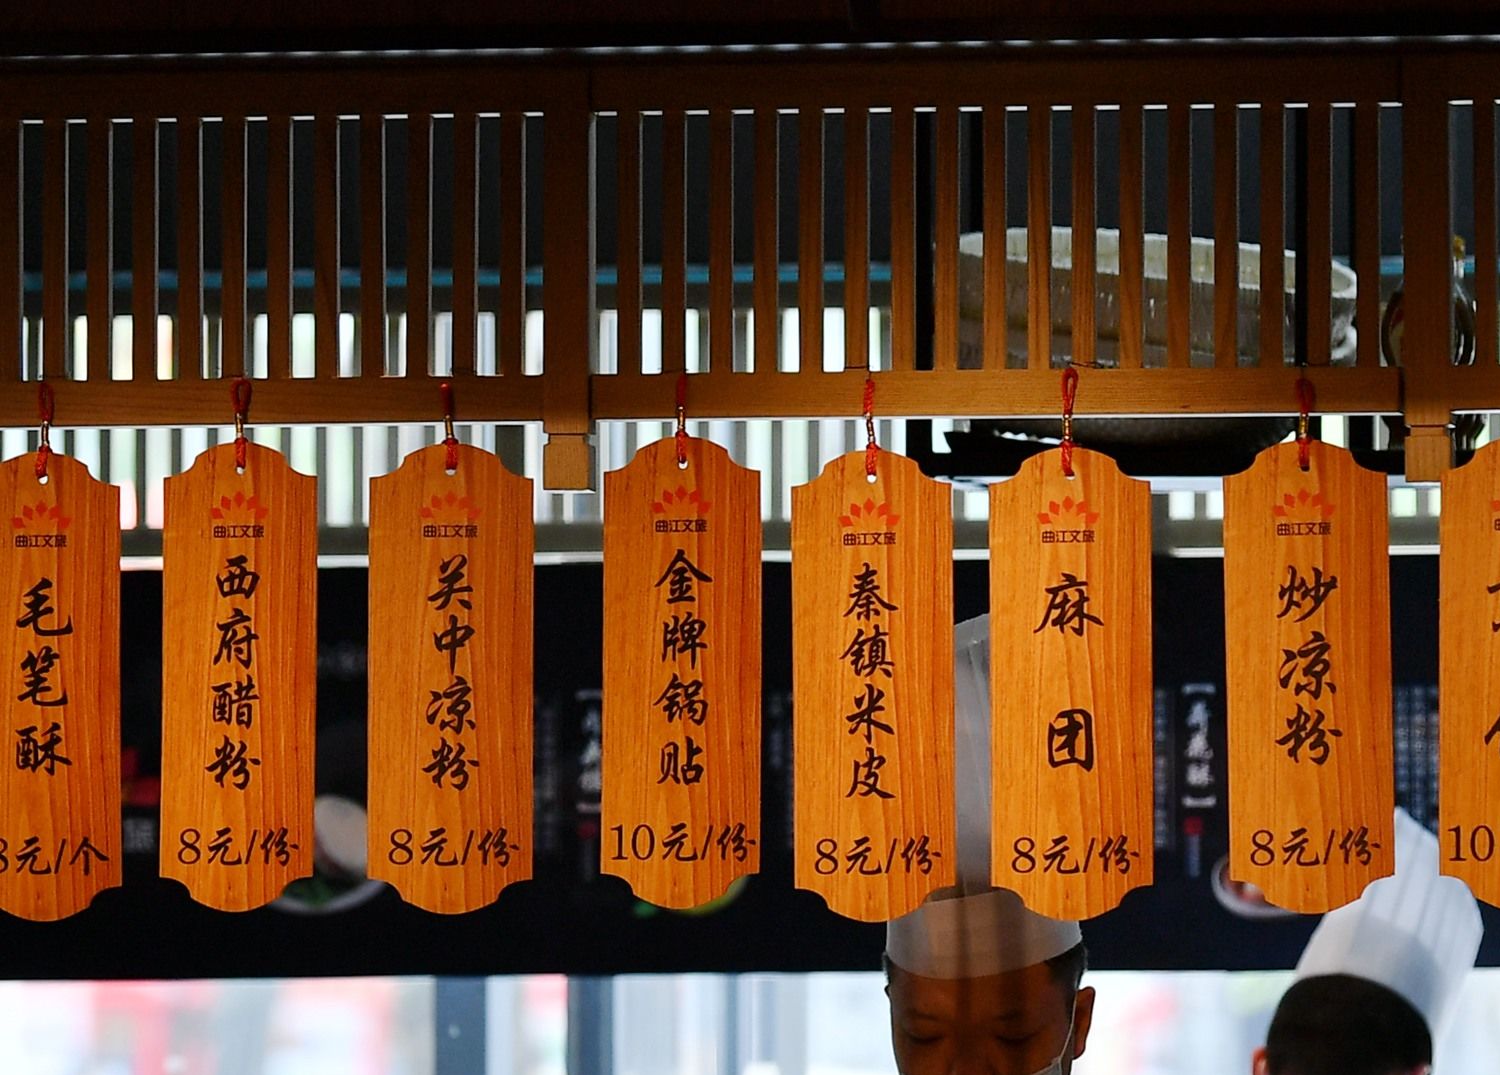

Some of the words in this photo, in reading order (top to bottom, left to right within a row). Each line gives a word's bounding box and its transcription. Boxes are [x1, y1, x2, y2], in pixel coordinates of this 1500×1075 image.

[14, 533, 67, 549] 曲江文旅
[213, 524, 265, 539] 曲江文旅
[422, 524, 478, 539] 曲江文旅
[655, 518, 708, 533] 曲江文旅
[843, 531, 897, 546] 曲江文旅
[1041, 529, 1095, 544] 曲江文旅
[1276, 521, 1331, 536] 曲江文旅
[15, 577, 74, 776] 毛笔酥
[205, 554, 261, 791] 西府醋粉
[422, 554, 480, 791] 关中凉粉
[653, 548, 713, 786] 金牌锅贴
[841, 562, 899, 799] 秦镇米皮
[1033, 572, 1104, 772] 麻团
[1275, 565, 1343, 766] 炒凉粉
[177, 827, 299, 867] 8元/份
[388, 827, 520, 868] 8元/份
[611, 822, 757, 863] 10元/份
[814, 835, 942, 876] 8元/份
[1011, 834, 1140, 875] 8元/份
[1249, 826, 1381, 867] 8元/份
